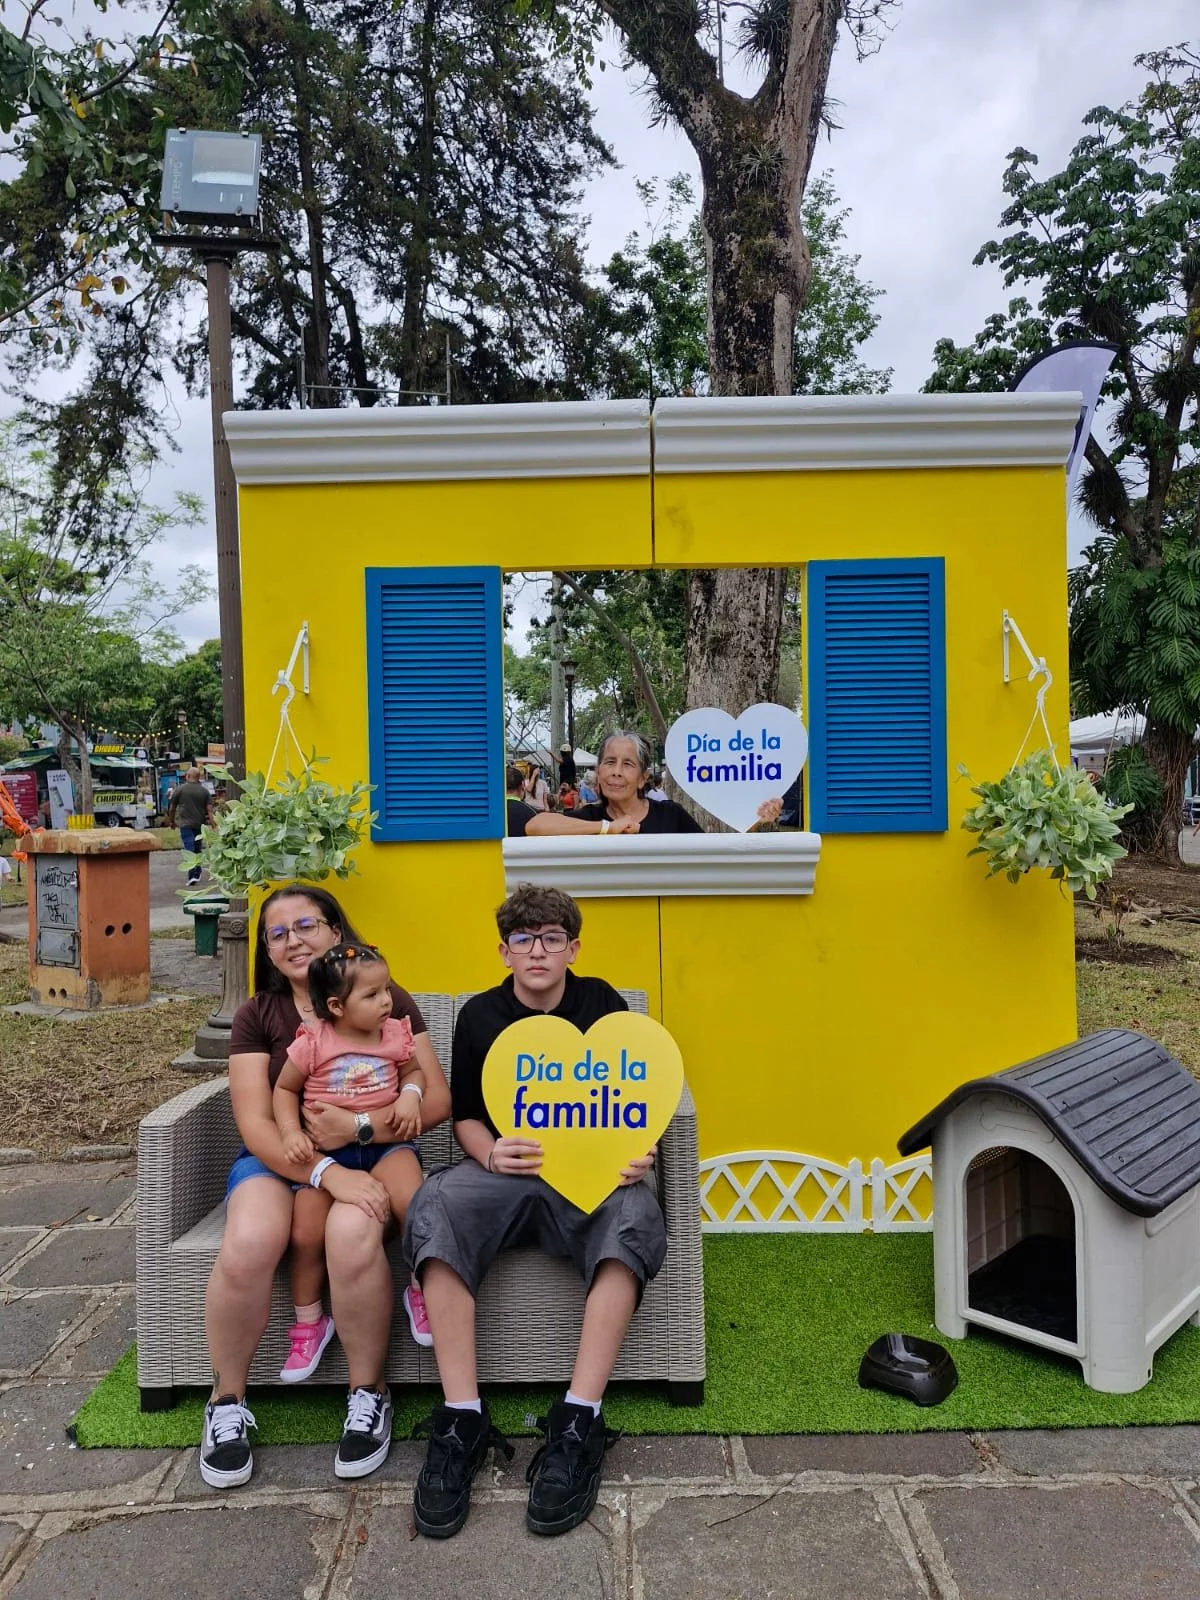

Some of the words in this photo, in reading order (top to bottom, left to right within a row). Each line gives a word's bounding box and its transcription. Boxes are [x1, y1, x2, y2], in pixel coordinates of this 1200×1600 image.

[94, 744, 125, 753] CHURROS
[687, 733, 721, 753] Día
[728, 729, 754, 751] de
[762, 728, 781, 749] la
[687, 753, 782, 783] familia
[96, 794, 132, 804] CHURROS
[516, 1053, 562, 1081] Día
[573, 1049, 610, 1081] de
[620, 1048, 647, 1081] la
[513, 1085, 647, 1129] familia
